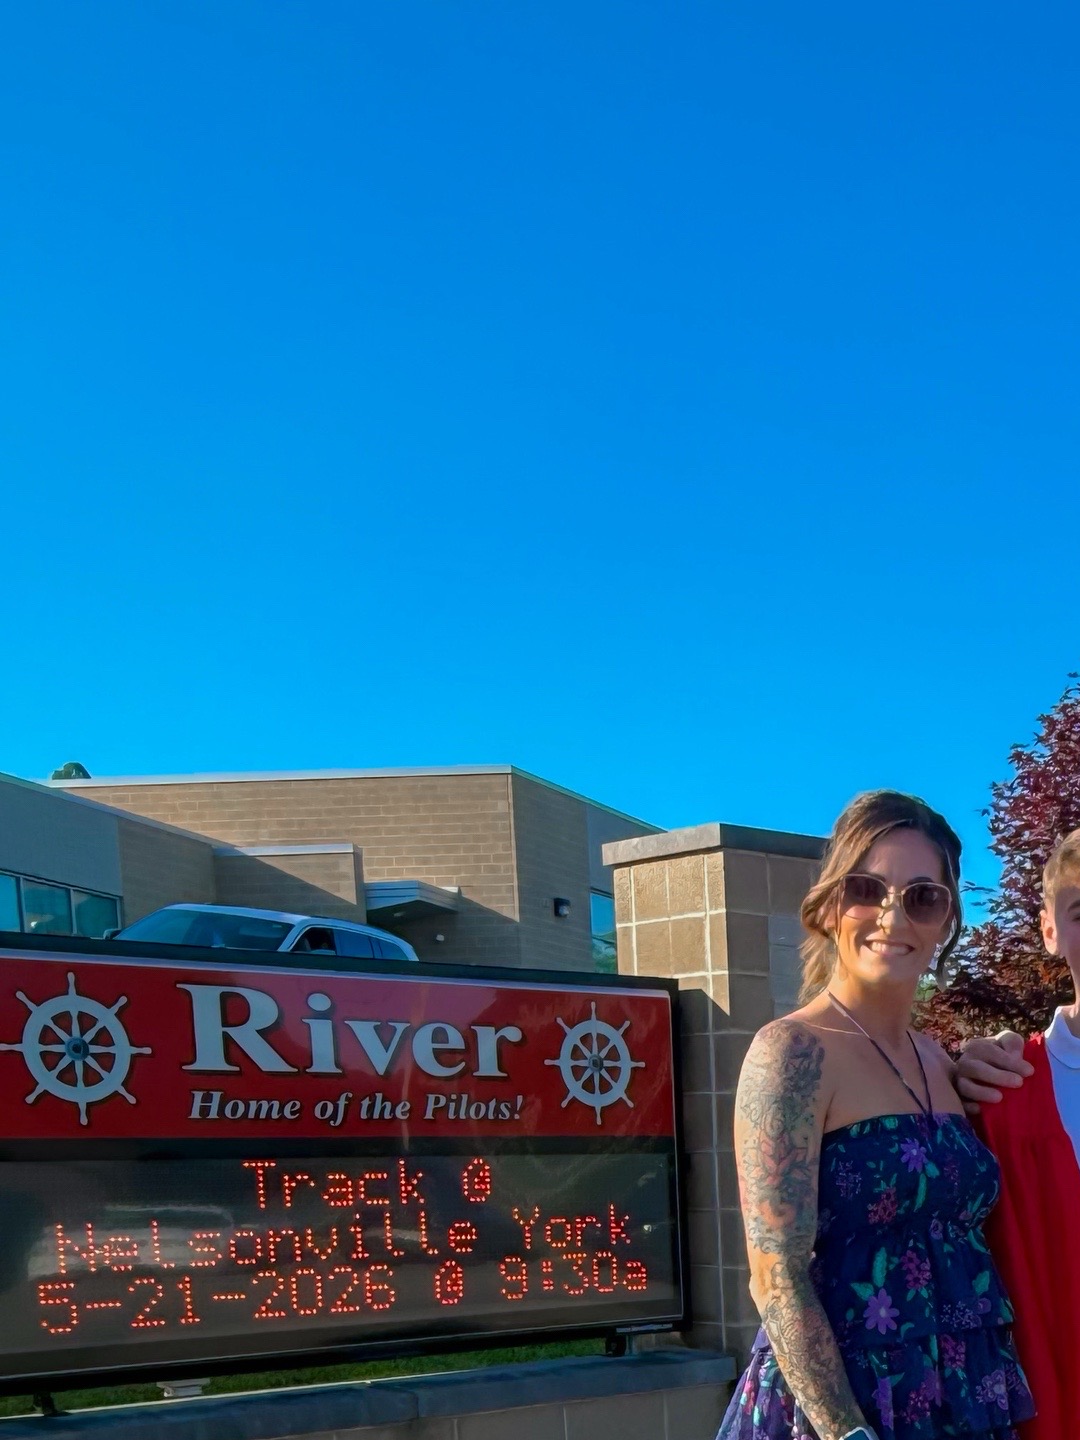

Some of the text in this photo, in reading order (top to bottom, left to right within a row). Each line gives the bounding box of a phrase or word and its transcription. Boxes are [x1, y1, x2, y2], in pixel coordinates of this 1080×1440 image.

[176, 983, 523, 1077] River
[188, 1090, 525, 1127] Home of the Pilots!
[243, 1157, 493, 1208] Track @
[55, 1203, 633, 1274] Nelsonville York
[37, 1251, 648, 1333] 5-21-2026 @ 9:30a
